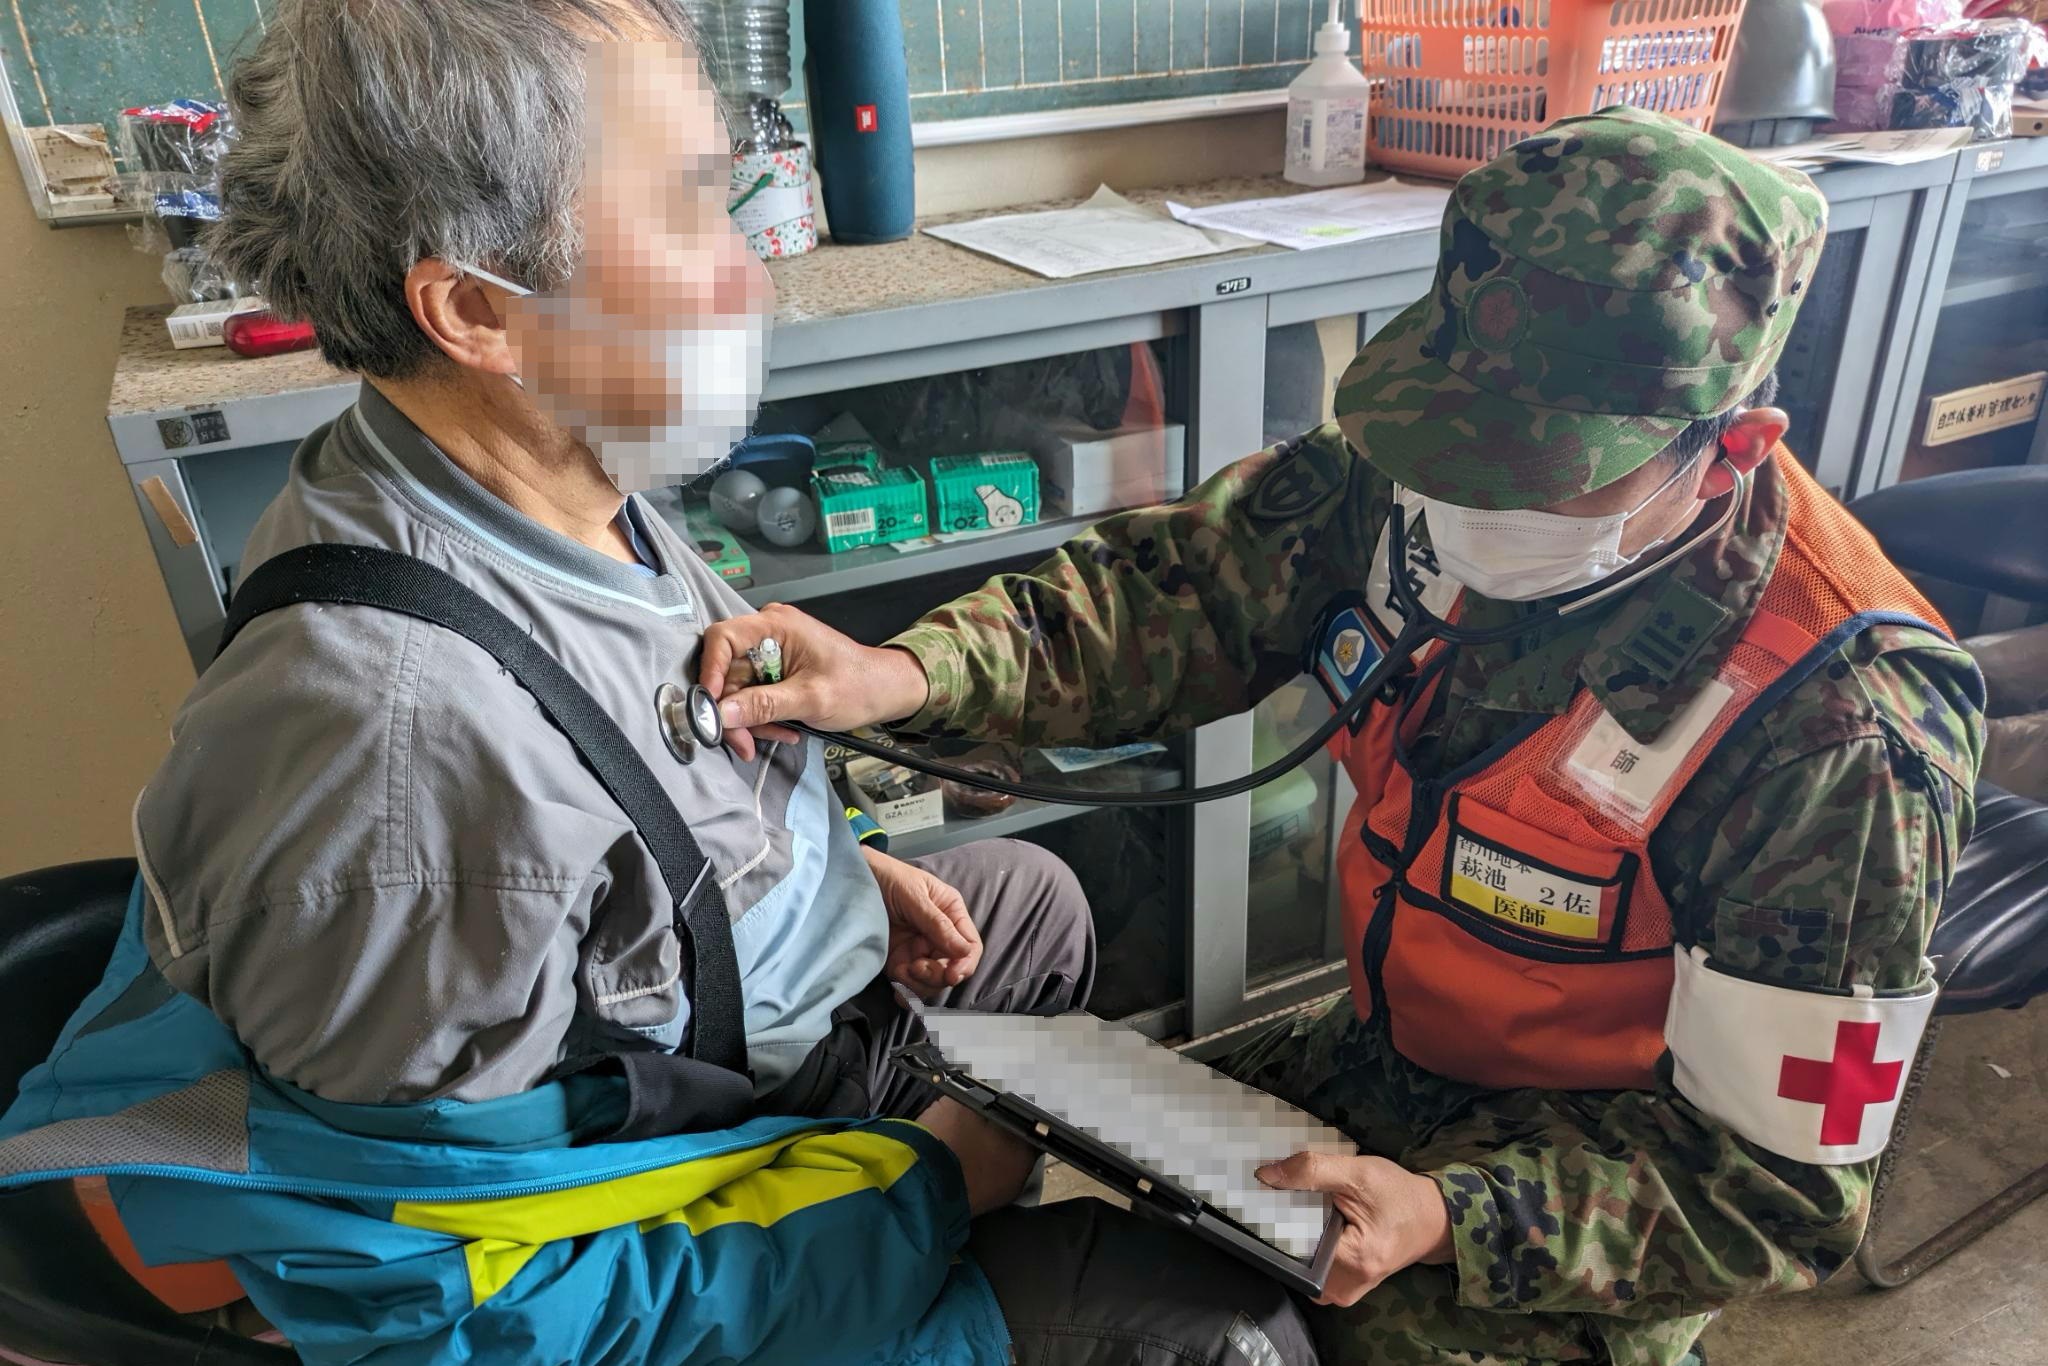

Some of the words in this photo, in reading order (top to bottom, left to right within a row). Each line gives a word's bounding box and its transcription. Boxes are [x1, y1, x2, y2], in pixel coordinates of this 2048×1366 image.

[1220, 278, 1248, 293] コクヨ
[878, 516, 897, 529] 20
[954, 515, 979, 530] 20
[1610, 749, 1640, 775] 師
[1460, 856, 1507, 892] 萩池
[1493, 895, 1548, 927] 医師
